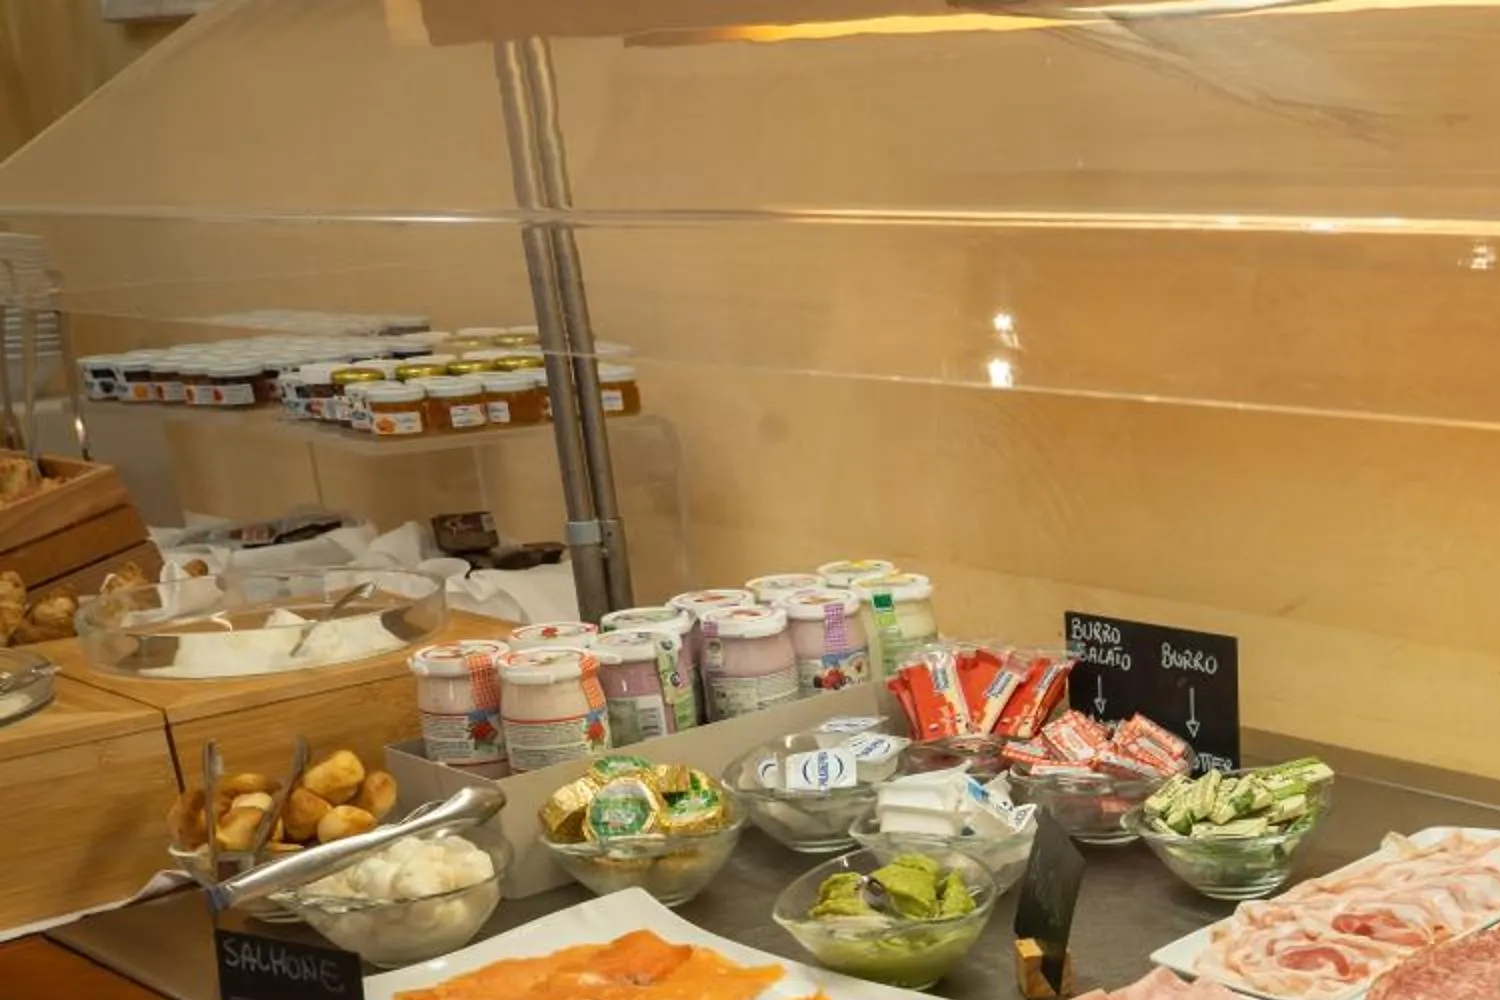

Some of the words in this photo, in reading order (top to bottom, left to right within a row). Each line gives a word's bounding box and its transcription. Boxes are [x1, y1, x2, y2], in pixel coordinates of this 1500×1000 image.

[1071, 617, 1121, 645] BURRO
[1161, 641, 1218, 675] BURRO
[223, 938, 345, 992] SALMONE
